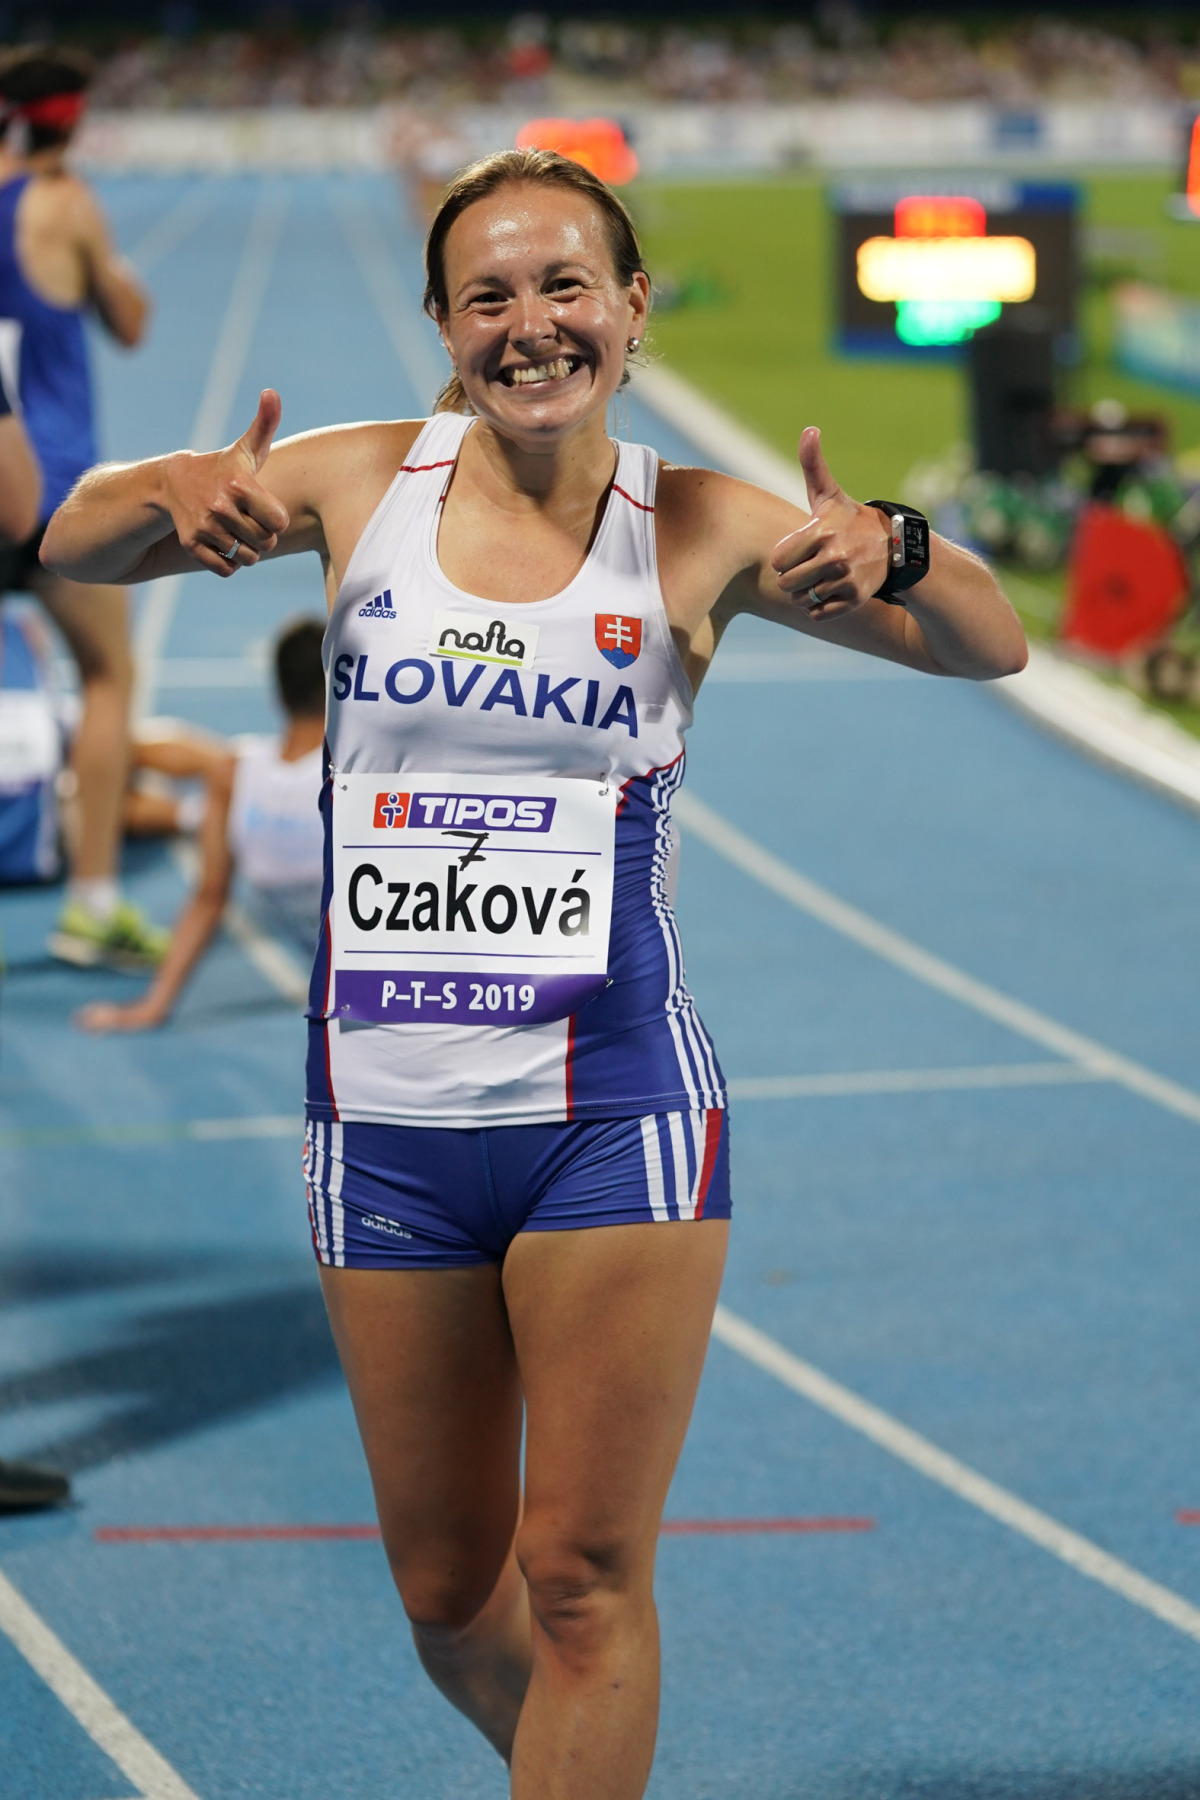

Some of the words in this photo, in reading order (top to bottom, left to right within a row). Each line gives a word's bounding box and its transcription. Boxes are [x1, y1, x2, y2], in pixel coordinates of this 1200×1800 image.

[358, 606, 397, 619] adidas
[438, 620, 526, 659] nafta
[332, 653, 638, 739] SLOVAKIA
[418, 796, 546, 829] TIPOS
[441, 830, 489, 871] 7
[348, 863, 591, 937] Czaková
[468, 983, 535, 1012] 2019
